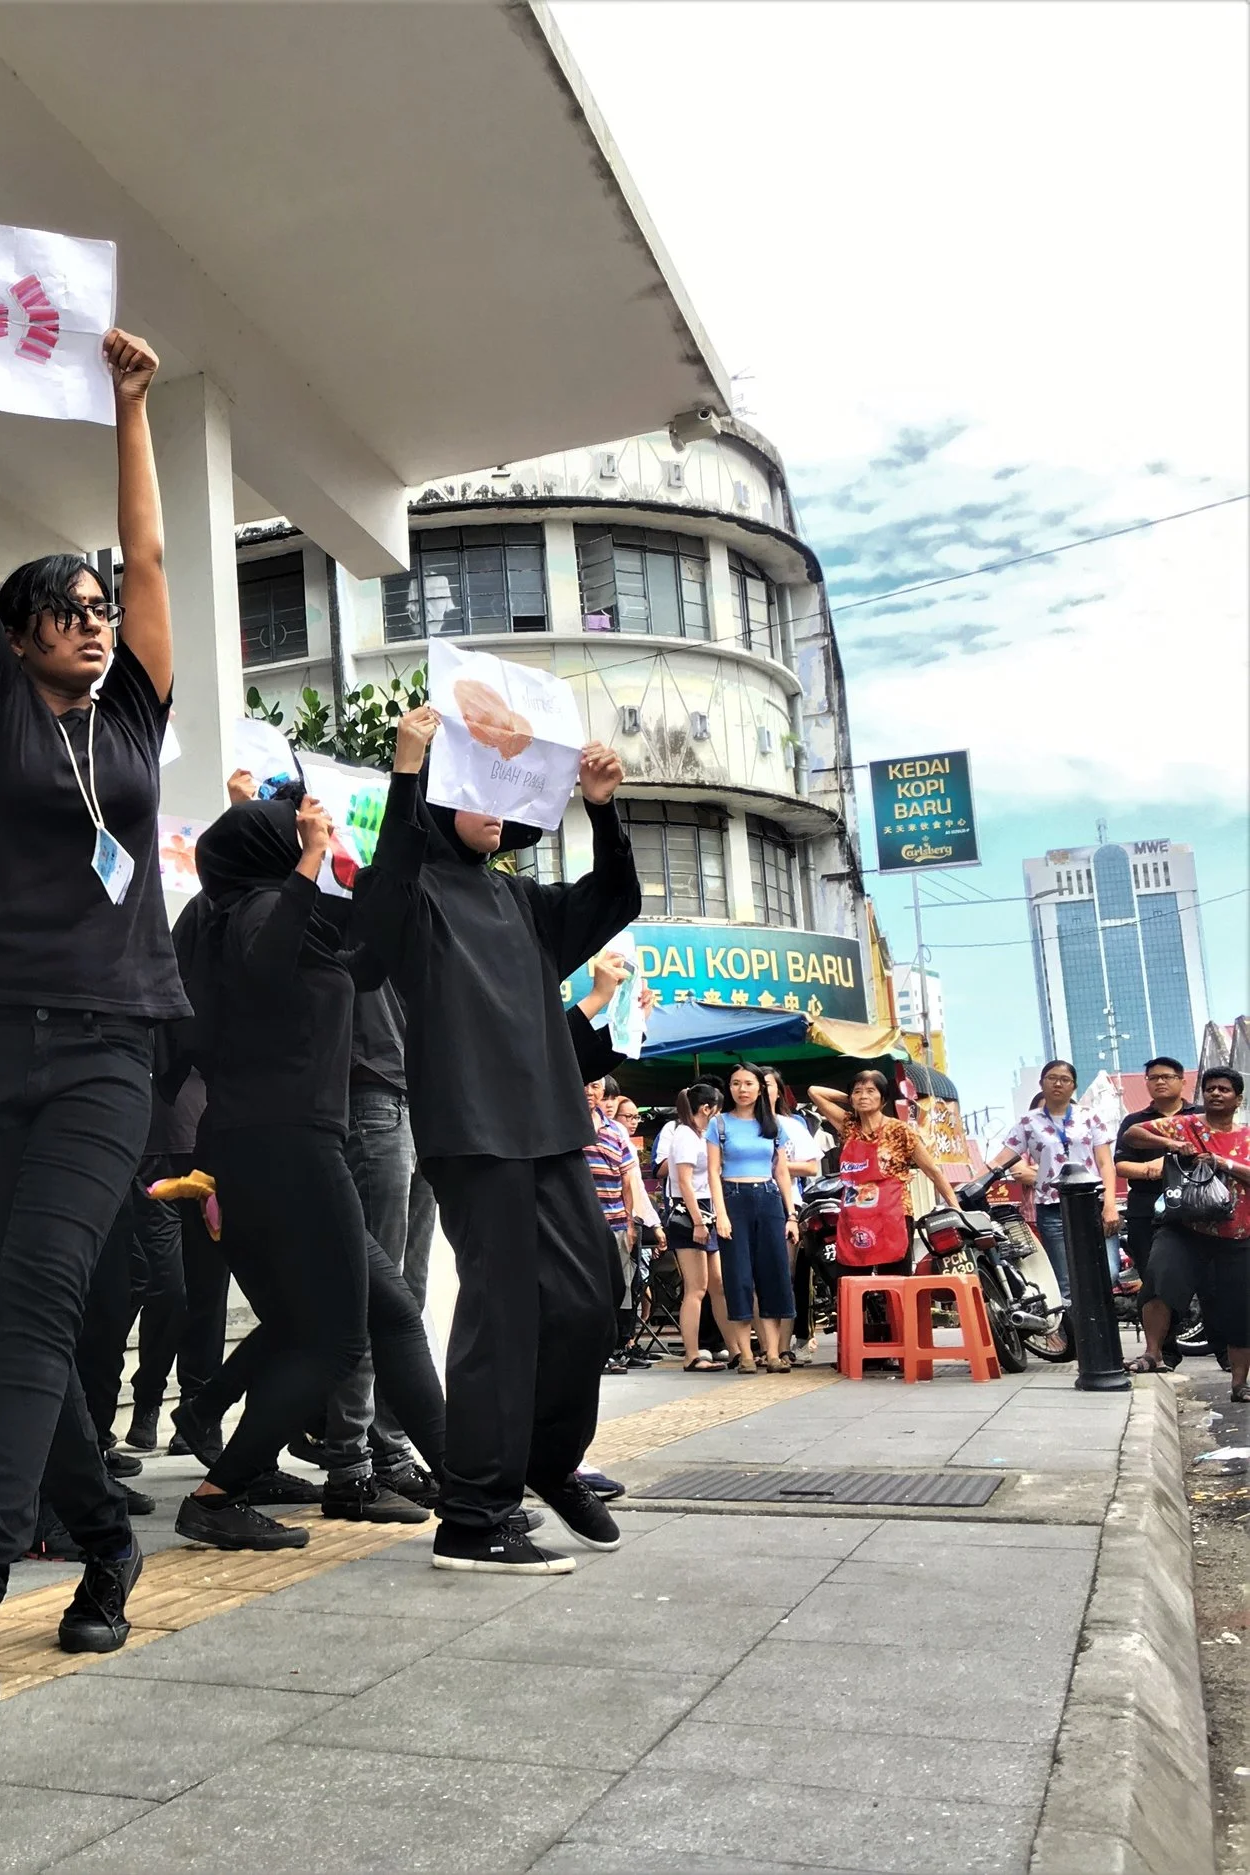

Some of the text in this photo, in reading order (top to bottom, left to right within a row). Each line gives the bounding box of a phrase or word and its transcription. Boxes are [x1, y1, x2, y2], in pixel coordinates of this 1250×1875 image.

[490, 760, 521, 786] BUAH
[888, 758, 950, 780] KEDAI
[897, 778, 945, 799] KOPI
[894, 798, 952, 819] BARU
[901, 842, 953, 862] Carlsberg
[1134, 840, 1169, 855] MWE
[706, 946, 779, 982] KOPI
[786, 949, 855, 988] BARU
[942, 1250, 968, 1268] PCN
